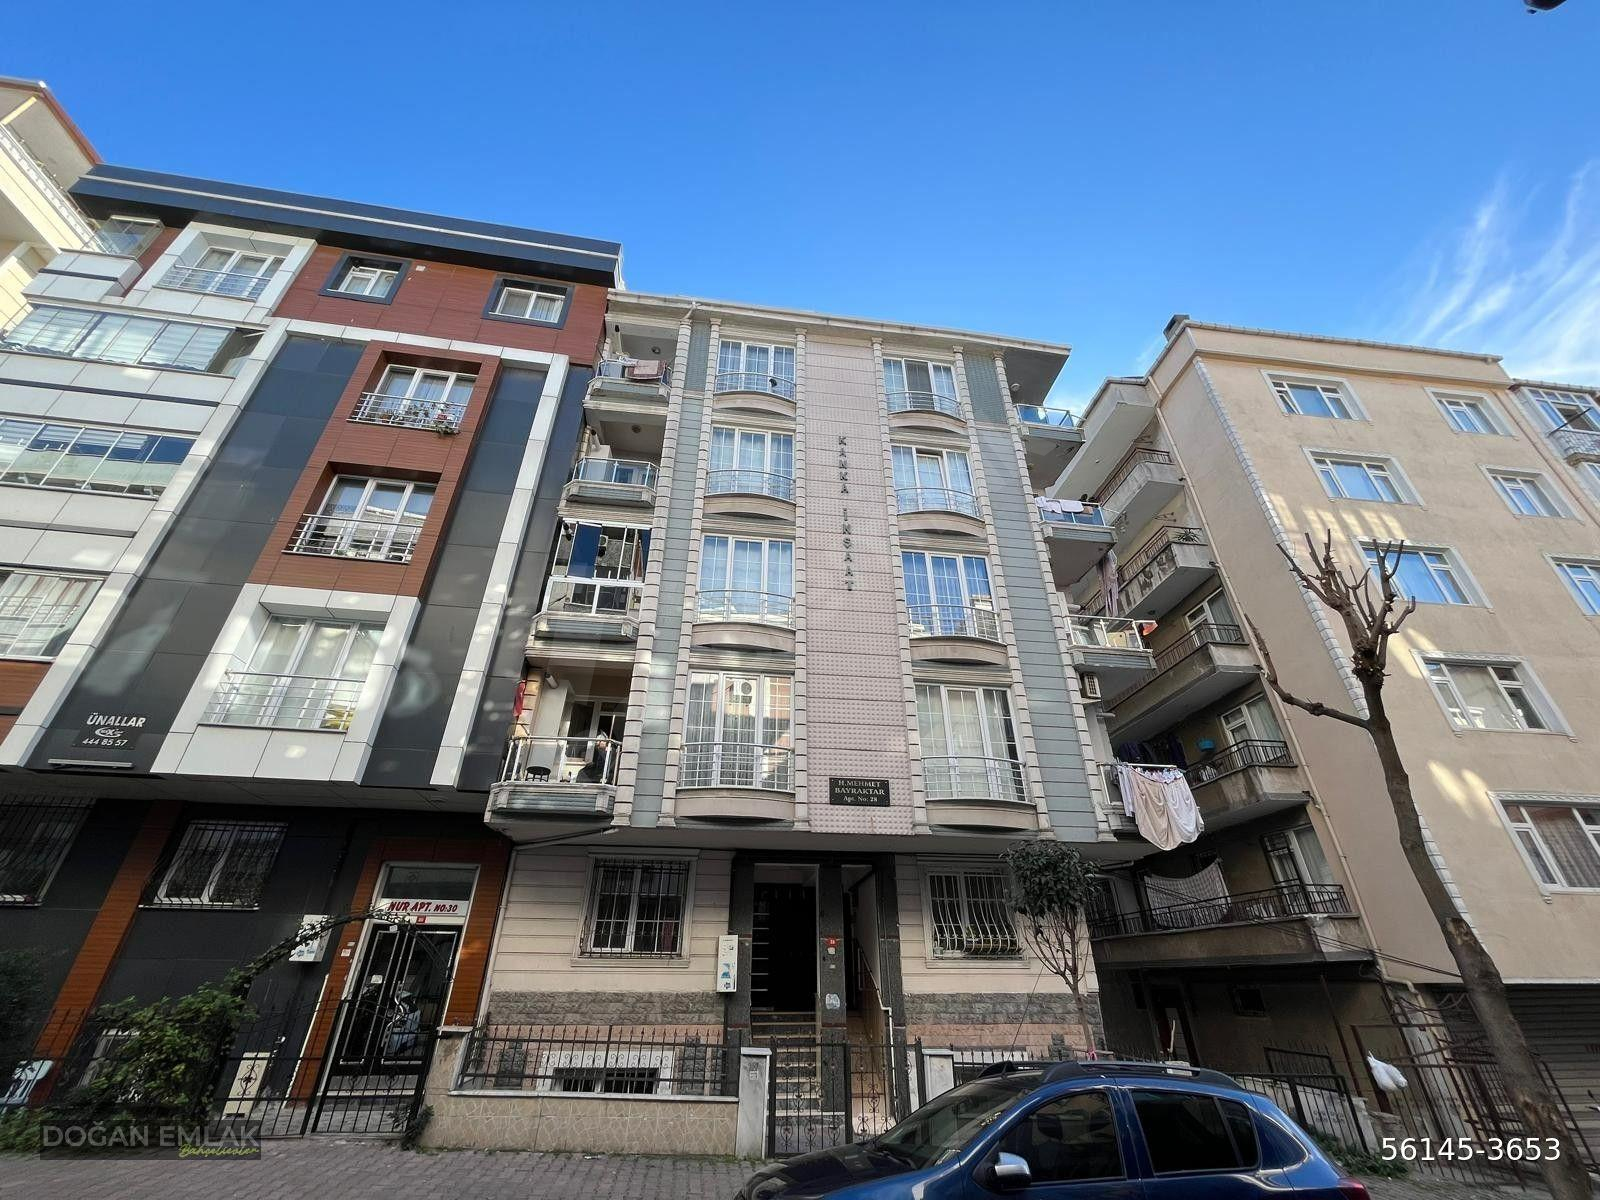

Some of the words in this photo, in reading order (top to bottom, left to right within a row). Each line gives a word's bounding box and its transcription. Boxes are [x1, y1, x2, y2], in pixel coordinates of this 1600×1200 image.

[86, 712, 146, 727] ÜNALLAR
[101, 738, 114, 746] 85
[834, 787, 885, 795] BAYRAKTAR
[387, 901, 411, 912] NUR
[411, 901, 433, 912] APT.
[433, 903, 458, 913] NO:30
